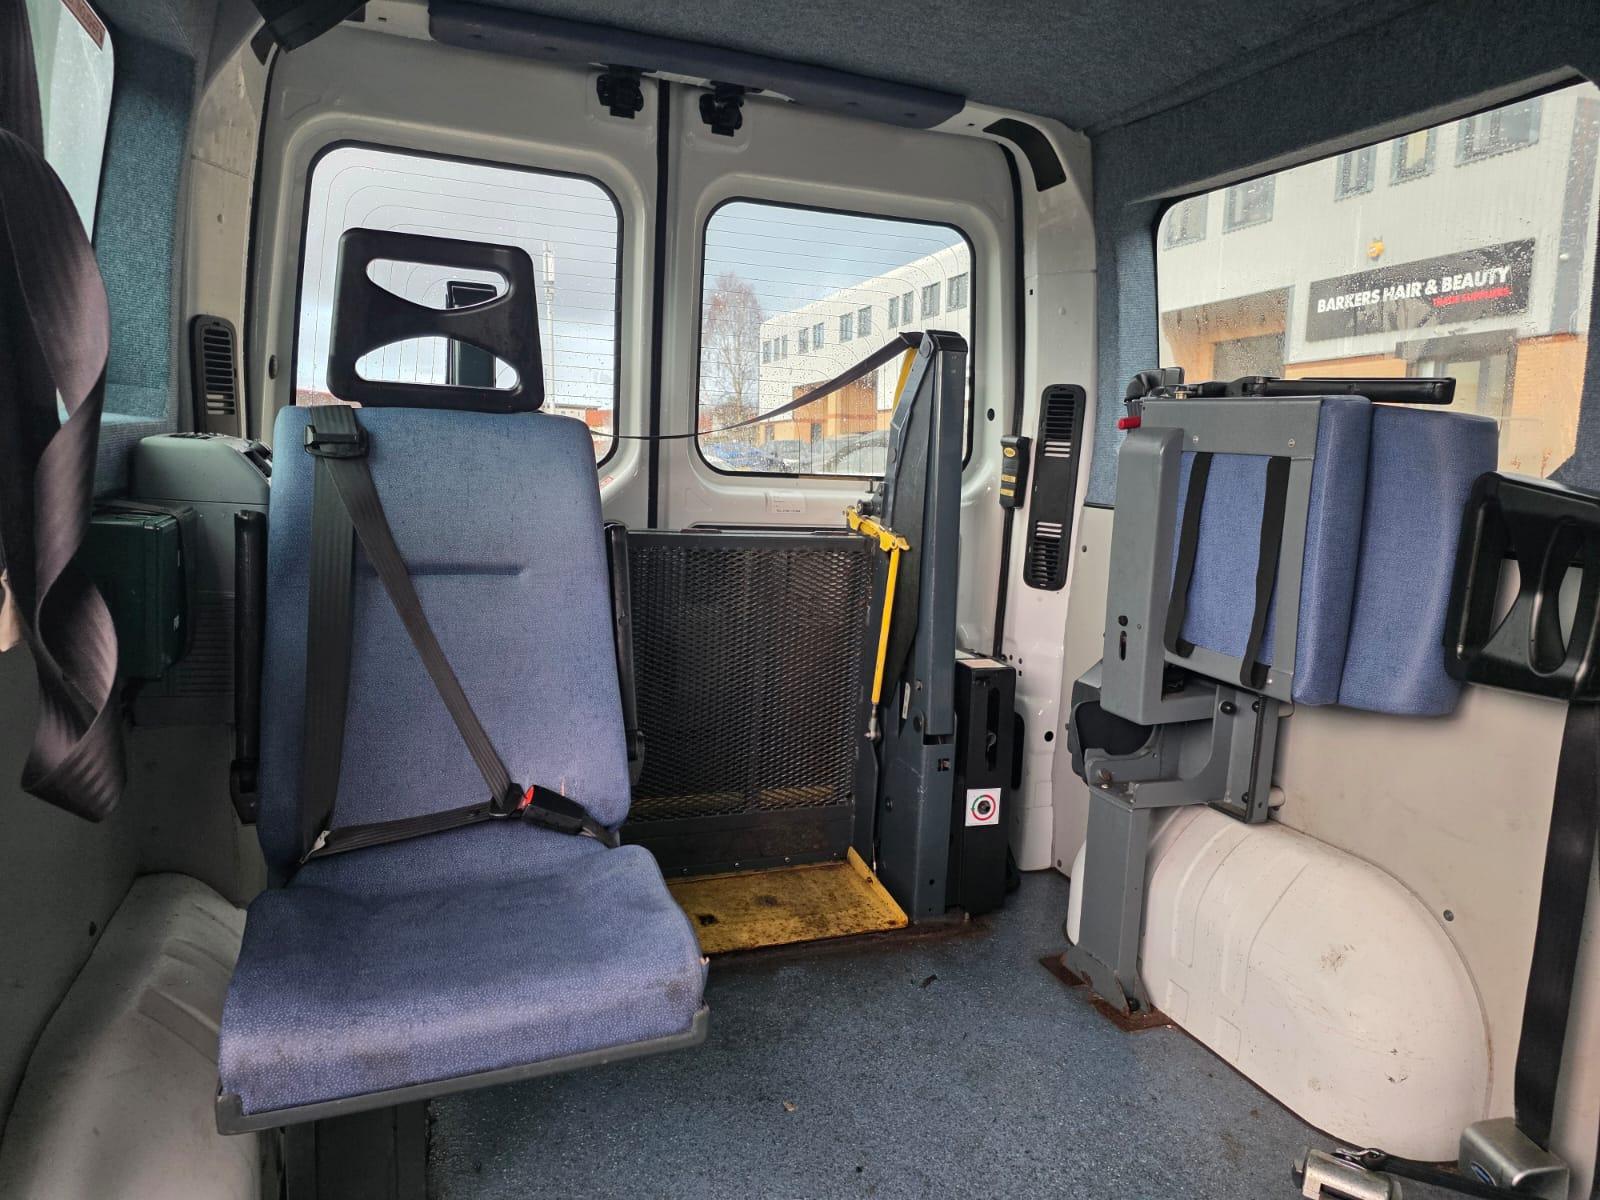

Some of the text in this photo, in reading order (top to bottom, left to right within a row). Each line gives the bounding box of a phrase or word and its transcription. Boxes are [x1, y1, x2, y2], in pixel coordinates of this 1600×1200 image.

[1317, 289, 1380, 313] BARKERS
[1383, 281, 1422, 302] HAIR
[1424, 279, 1438, 295] &
[1441, 264, 1511, 293] BEAUTY
